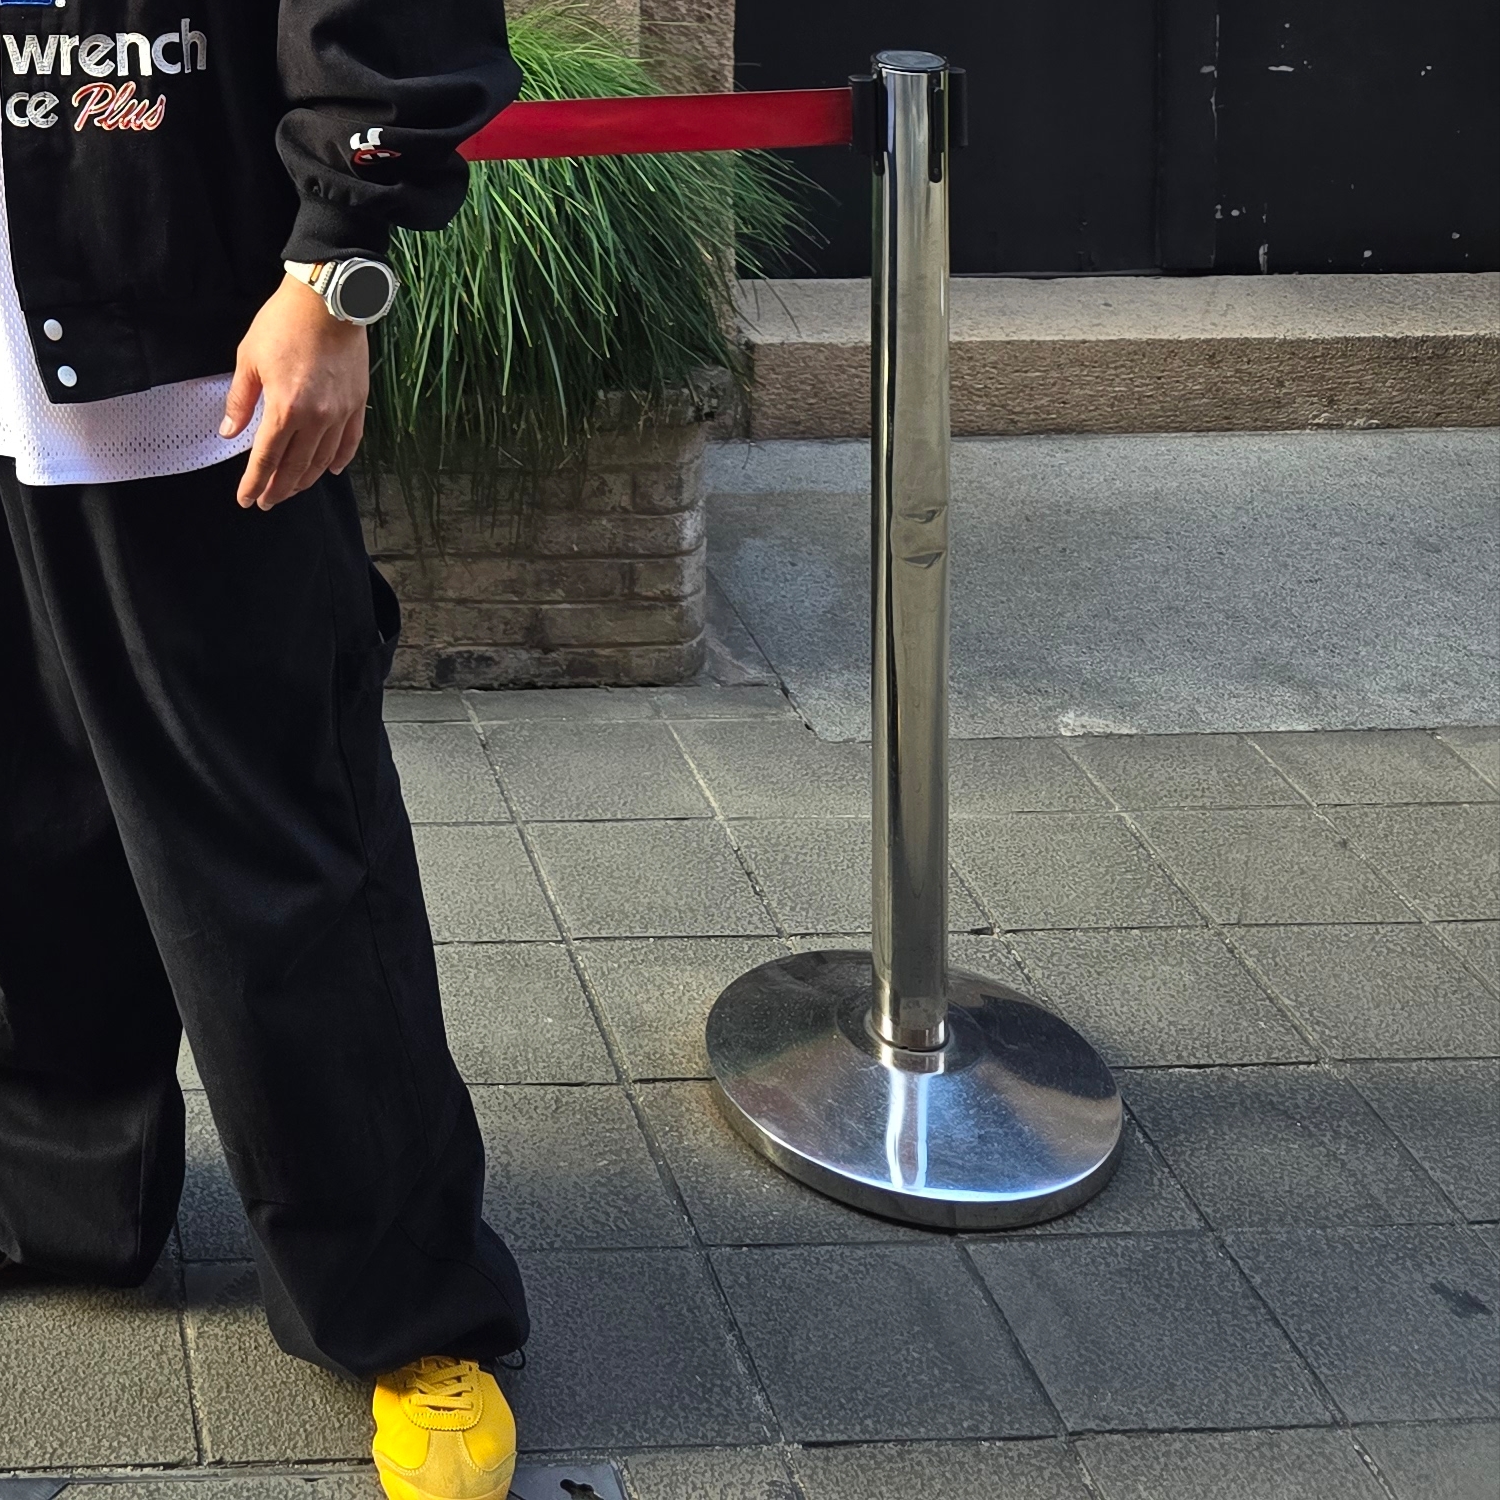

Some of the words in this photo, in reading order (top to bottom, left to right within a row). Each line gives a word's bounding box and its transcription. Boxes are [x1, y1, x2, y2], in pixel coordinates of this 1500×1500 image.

[2, 18, 207, 77] wrench
[5, 91, 59, 129] ce
[71, 80, 168, 132] Plus
